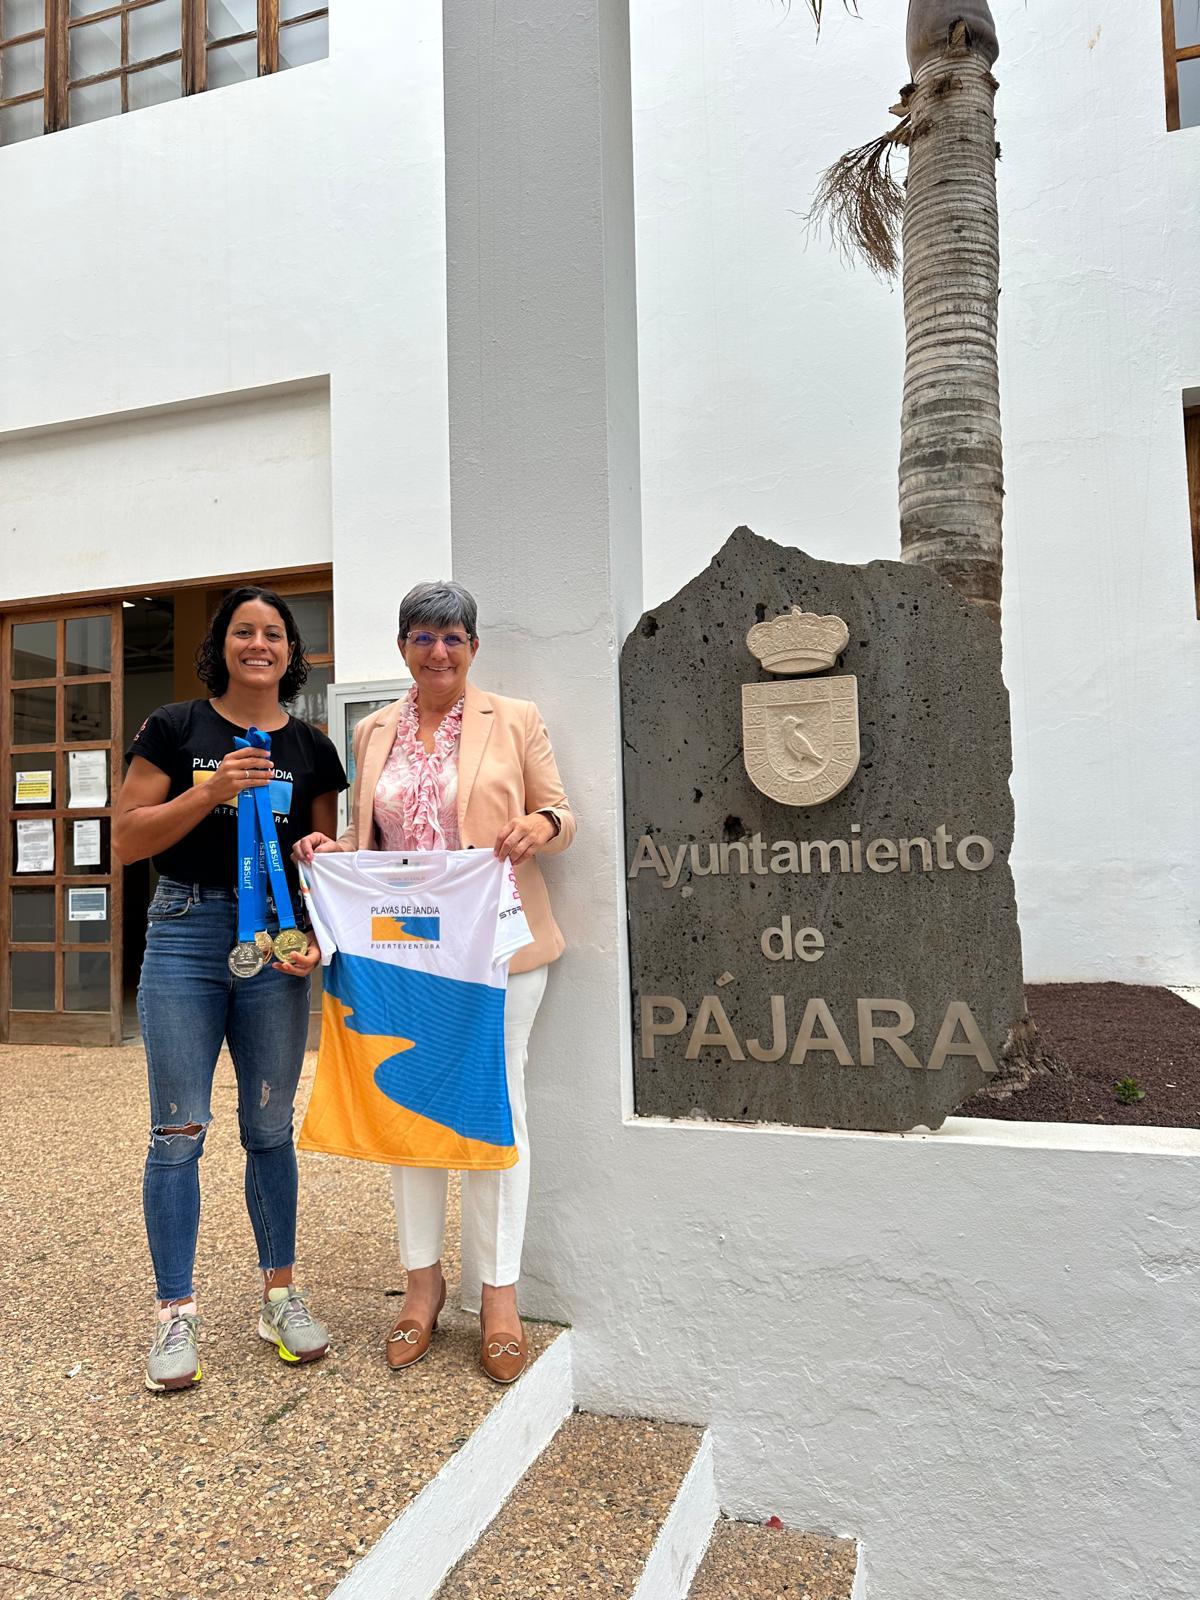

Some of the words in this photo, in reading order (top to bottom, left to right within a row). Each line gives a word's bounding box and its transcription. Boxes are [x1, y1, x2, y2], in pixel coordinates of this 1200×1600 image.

[192, 757, 222, 769] PLAY
[269, 840, 283, 872] isasurf
[628, 823, 995, 889] Ayuntamiento
[244, 857, 254, 890] isasurf
[370, 906, 399, 915] PLAYAS
[401, 905, 412, 915] DE
[370, 942, 440, 950] FUERTEVENTURA
[760, 915, 826, 962] de
[640, 970, 999, 1073] PÁJARA
